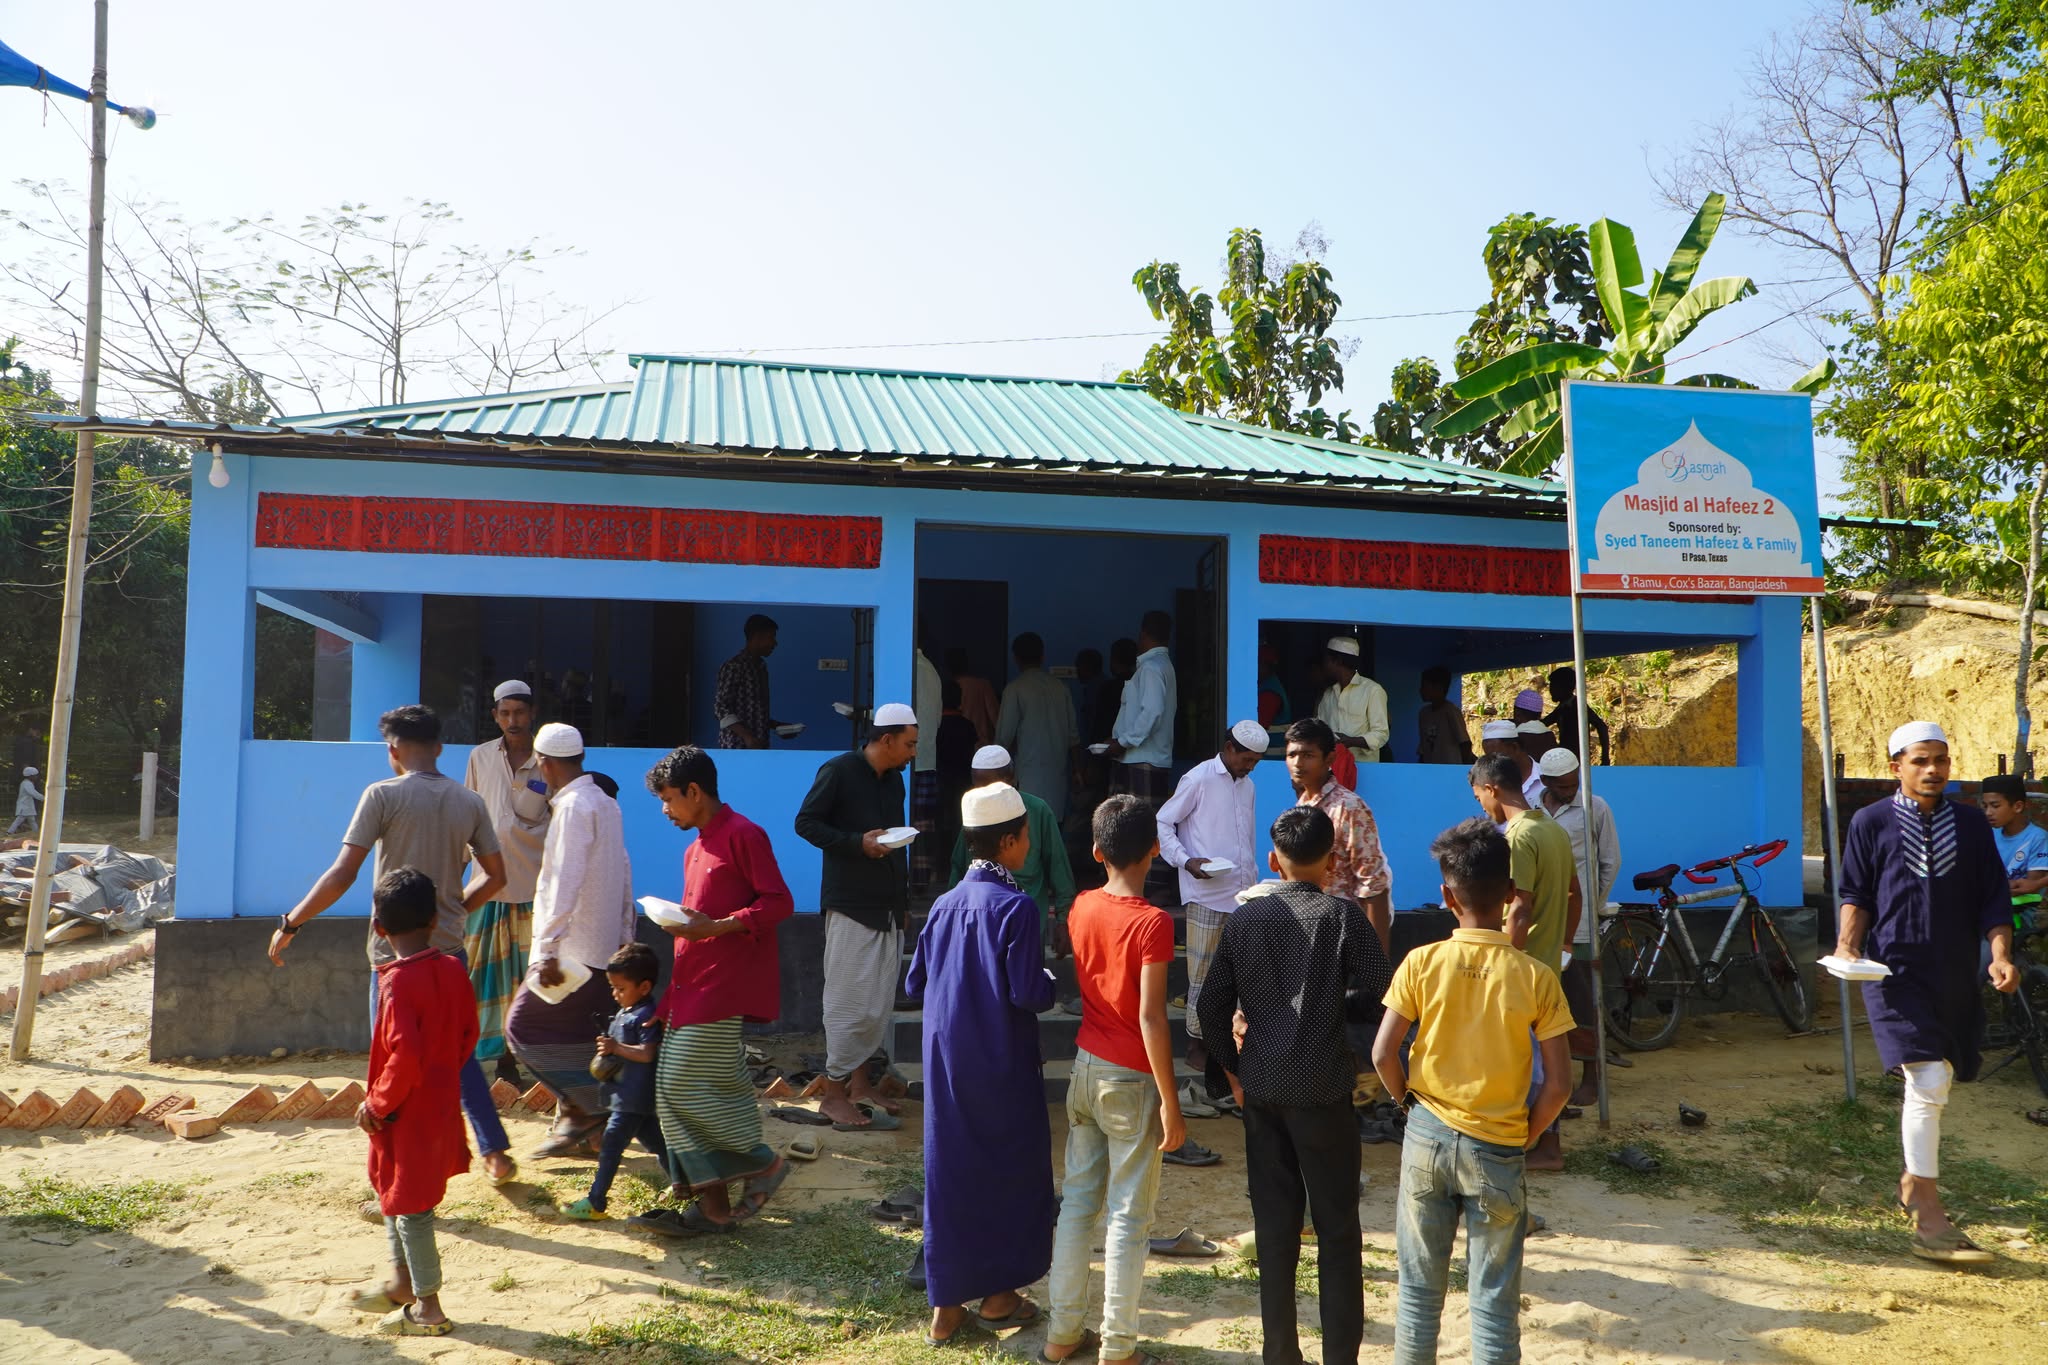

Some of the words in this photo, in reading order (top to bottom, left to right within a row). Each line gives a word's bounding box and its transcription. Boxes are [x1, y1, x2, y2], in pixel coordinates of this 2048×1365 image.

[1661, 450, 1727, 482] Basmah
[1624, 494, 1679, 516] Masjid
[1684, 497, 1698, 513] al
[1704, 497, 1758, 514] Hafeez
[1763, 498, 1774, 515] 2
[1668, 521, 1724, 535] Sponsored
[1727, 523, 1741, 536] by:
[1605, 533, 1636, 550] Syed
[1640, 534, 1691, 549] Taneem
[1695, 535, 1738, 549] Hafeez
[1742, 537, 1753, 550] &
[1757, 537, 1797, 553] Family
[1682, 552, 1688, 561] El
[1689, 552, 1707, 563] Paso,
[1708, 553, 1728, 562] Texas
[1632, 576, 1661, 588] Ramu
[1669, 577, 1696, 589] Cox's
[1698, 578, 1727, 590] Bazar,
[1729, 578, 1787, 591] Bangladesh
